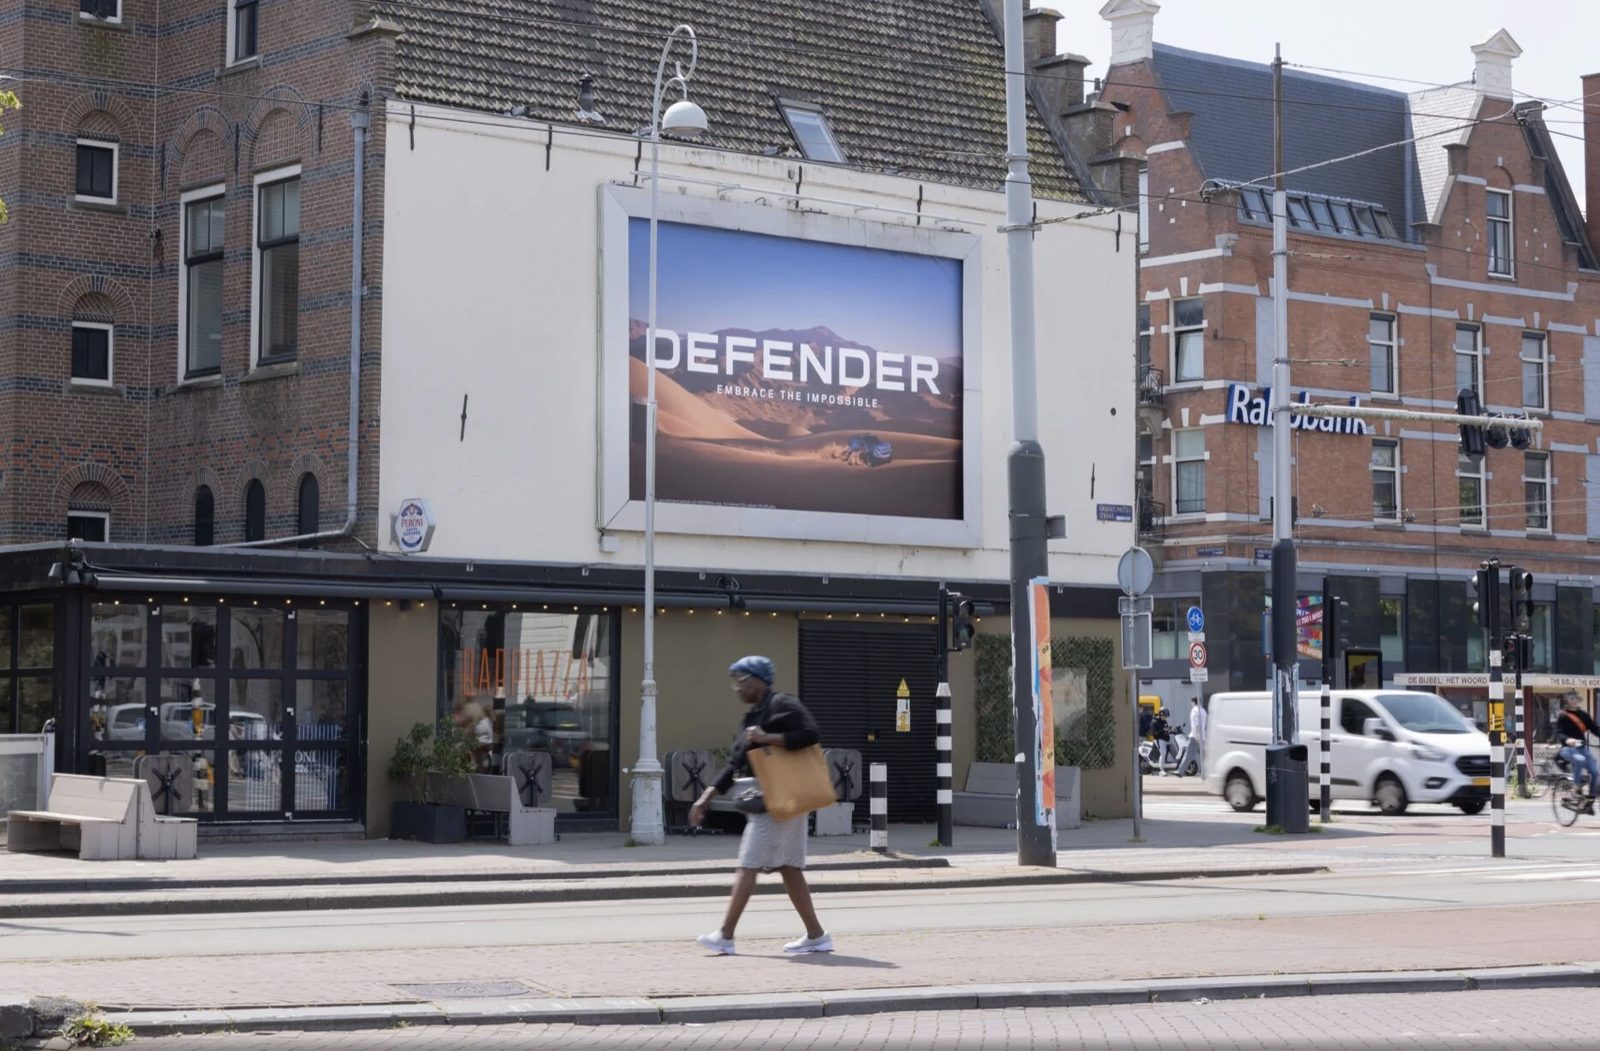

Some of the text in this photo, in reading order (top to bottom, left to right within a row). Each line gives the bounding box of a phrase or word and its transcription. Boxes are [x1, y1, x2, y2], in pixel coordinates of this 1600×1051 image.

[646, 328, 940, 395] DEFENDER
[717, 385, 878, 408] EMBRACE THE IMPOSSIBLE
[1227, 384, 1368, 435] Rabank
[1193, 649, 1204, 660] 30
[1408, 676, 1417, 684] DE
[1446, 676, 1459, 684] HET
[1461, 676, 1488, 684] WOORD
[1504, 677, 1516, 685] GO
